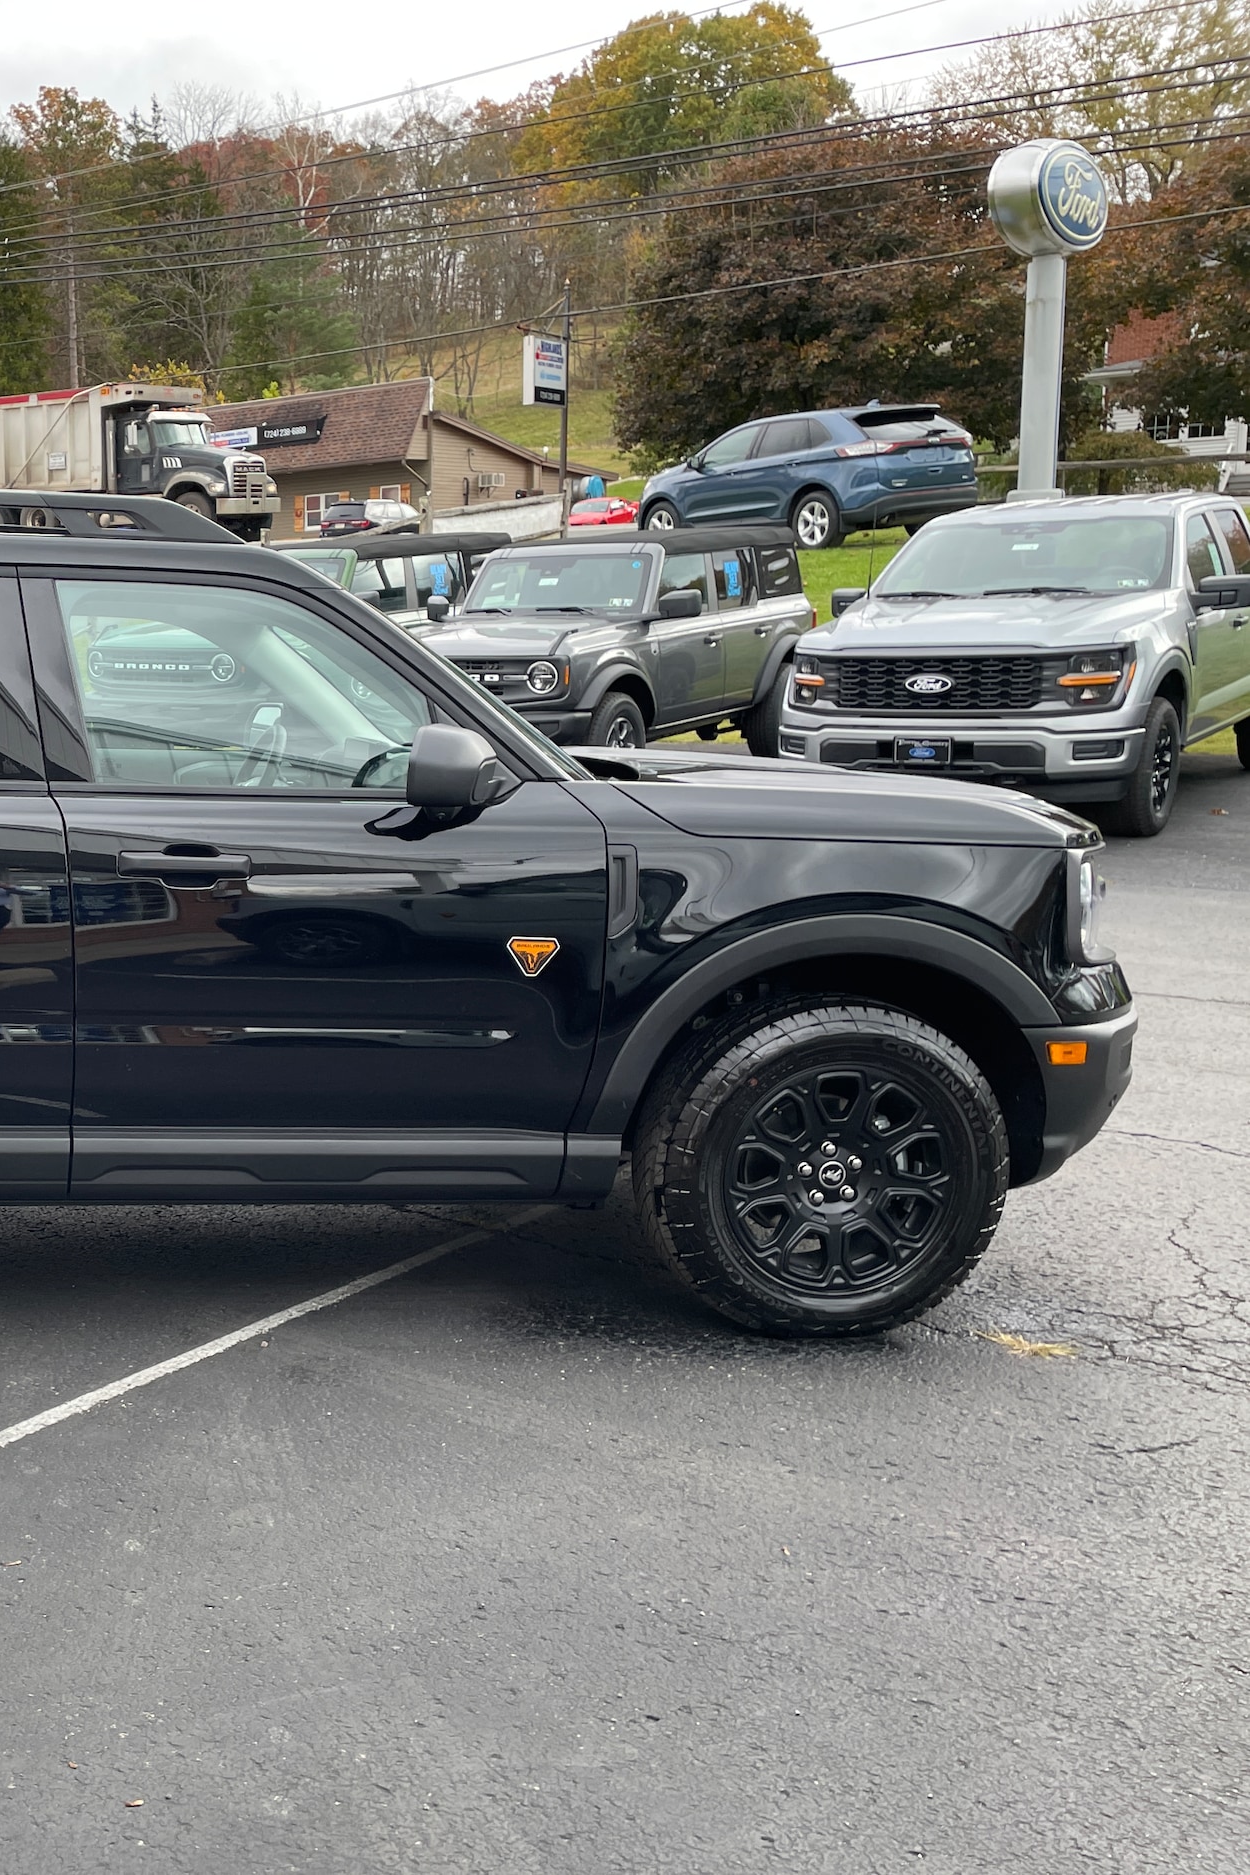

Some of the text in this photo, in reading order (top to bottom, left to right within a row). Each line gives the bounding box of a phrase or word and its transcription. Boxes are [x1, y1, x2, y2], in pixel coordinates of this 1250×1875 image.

[1057, 161, 1102, 230] Ford
[114, 662, 190, 671] BRONCO
[913, 677, 943, 691] Ford
